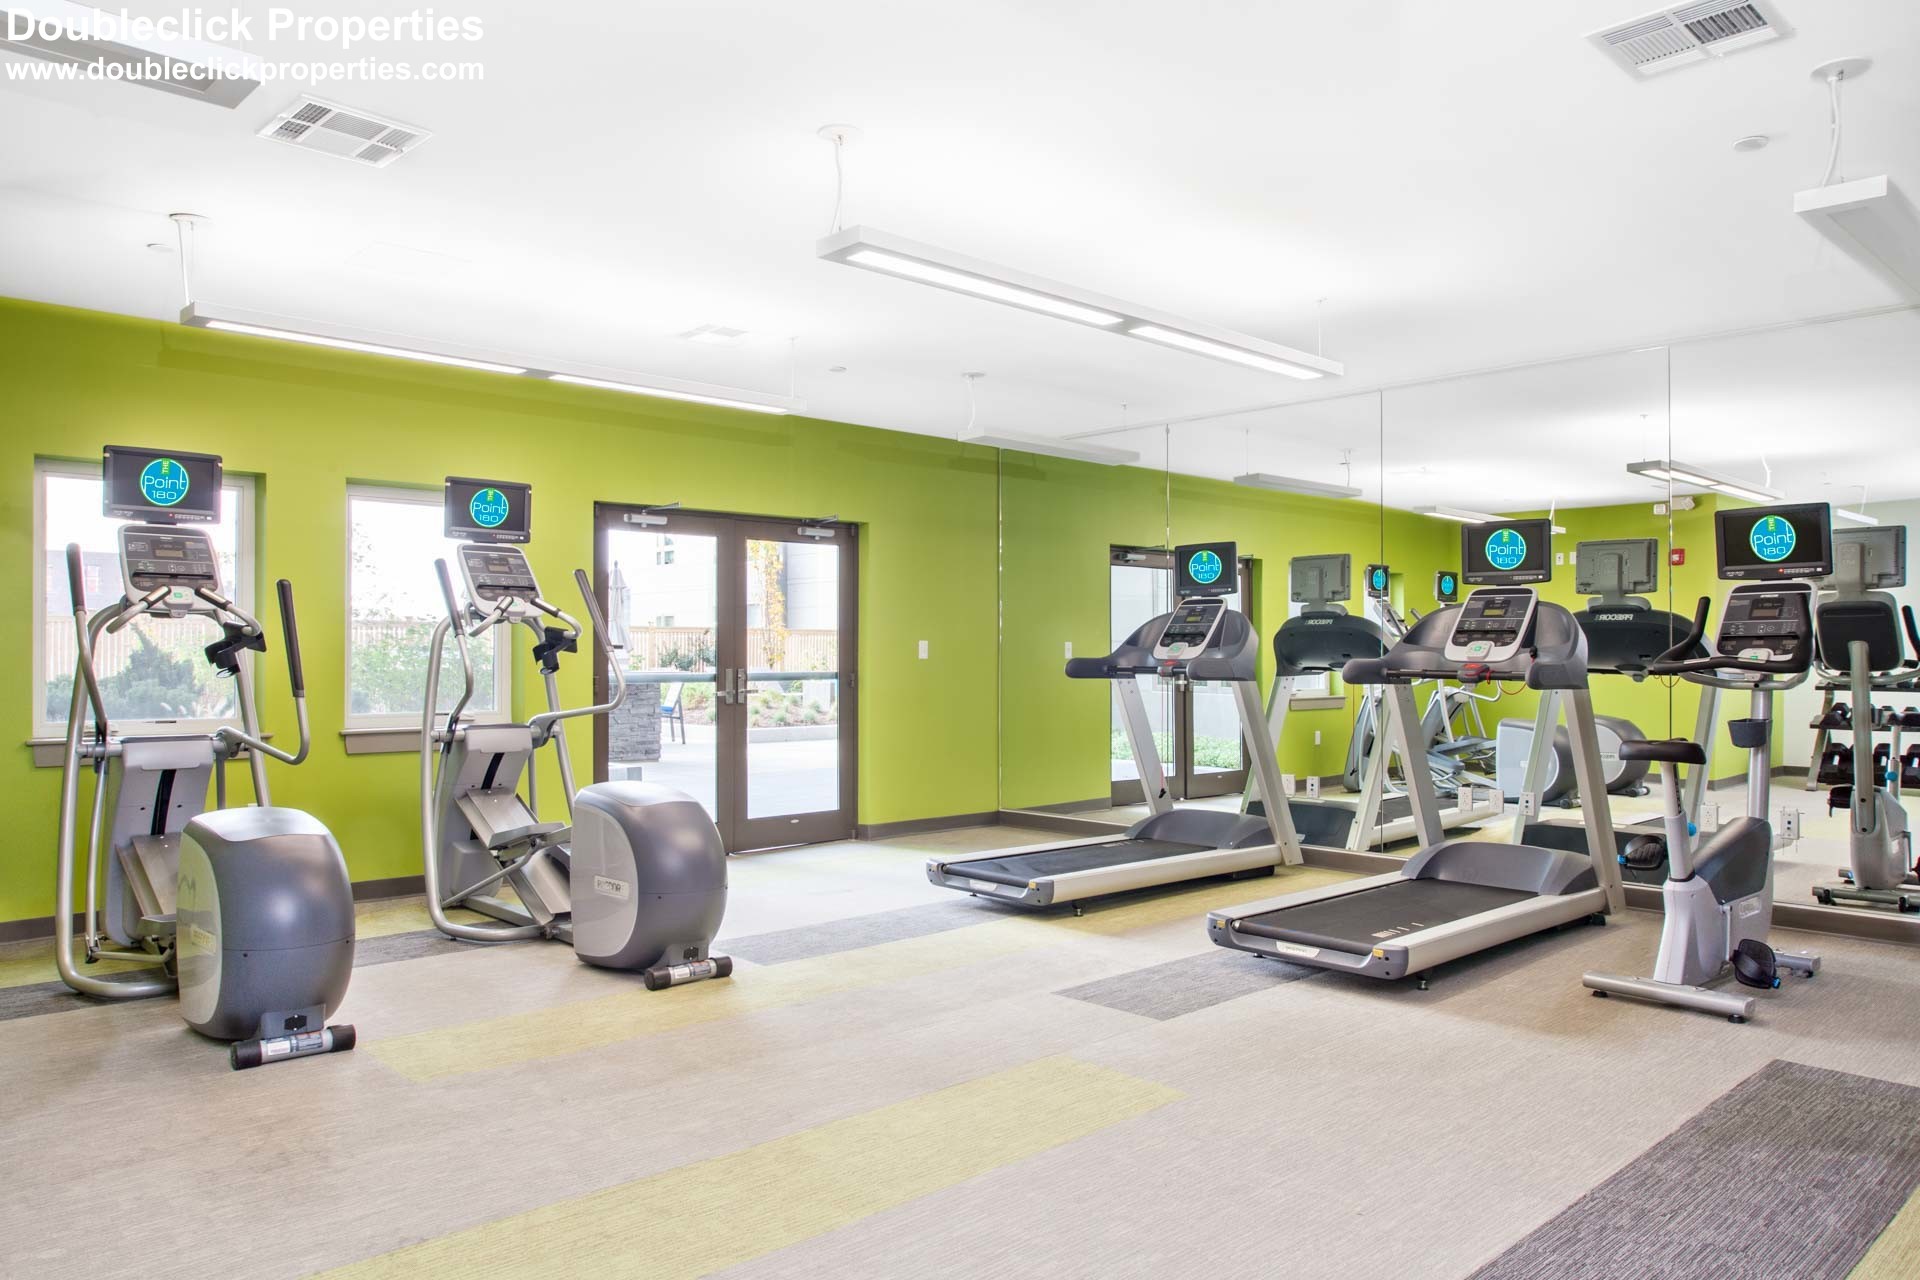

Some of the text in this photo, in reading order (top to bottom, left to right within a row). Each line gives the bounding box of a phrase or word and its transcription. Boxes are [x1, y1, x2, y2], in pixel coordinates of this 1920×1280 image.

[144, 468, 186, 493] Point
[152, 490, 177, 500] 180
[472, 497, 507, 516] Point
[479, 514, 499, 523] 180
[1753, 523, 1793, 552] Point
[1489, 537, 1524, 560] Point
[1763, 546, 1786, 555] 180
[1191, 556, 1220, 574] Point
